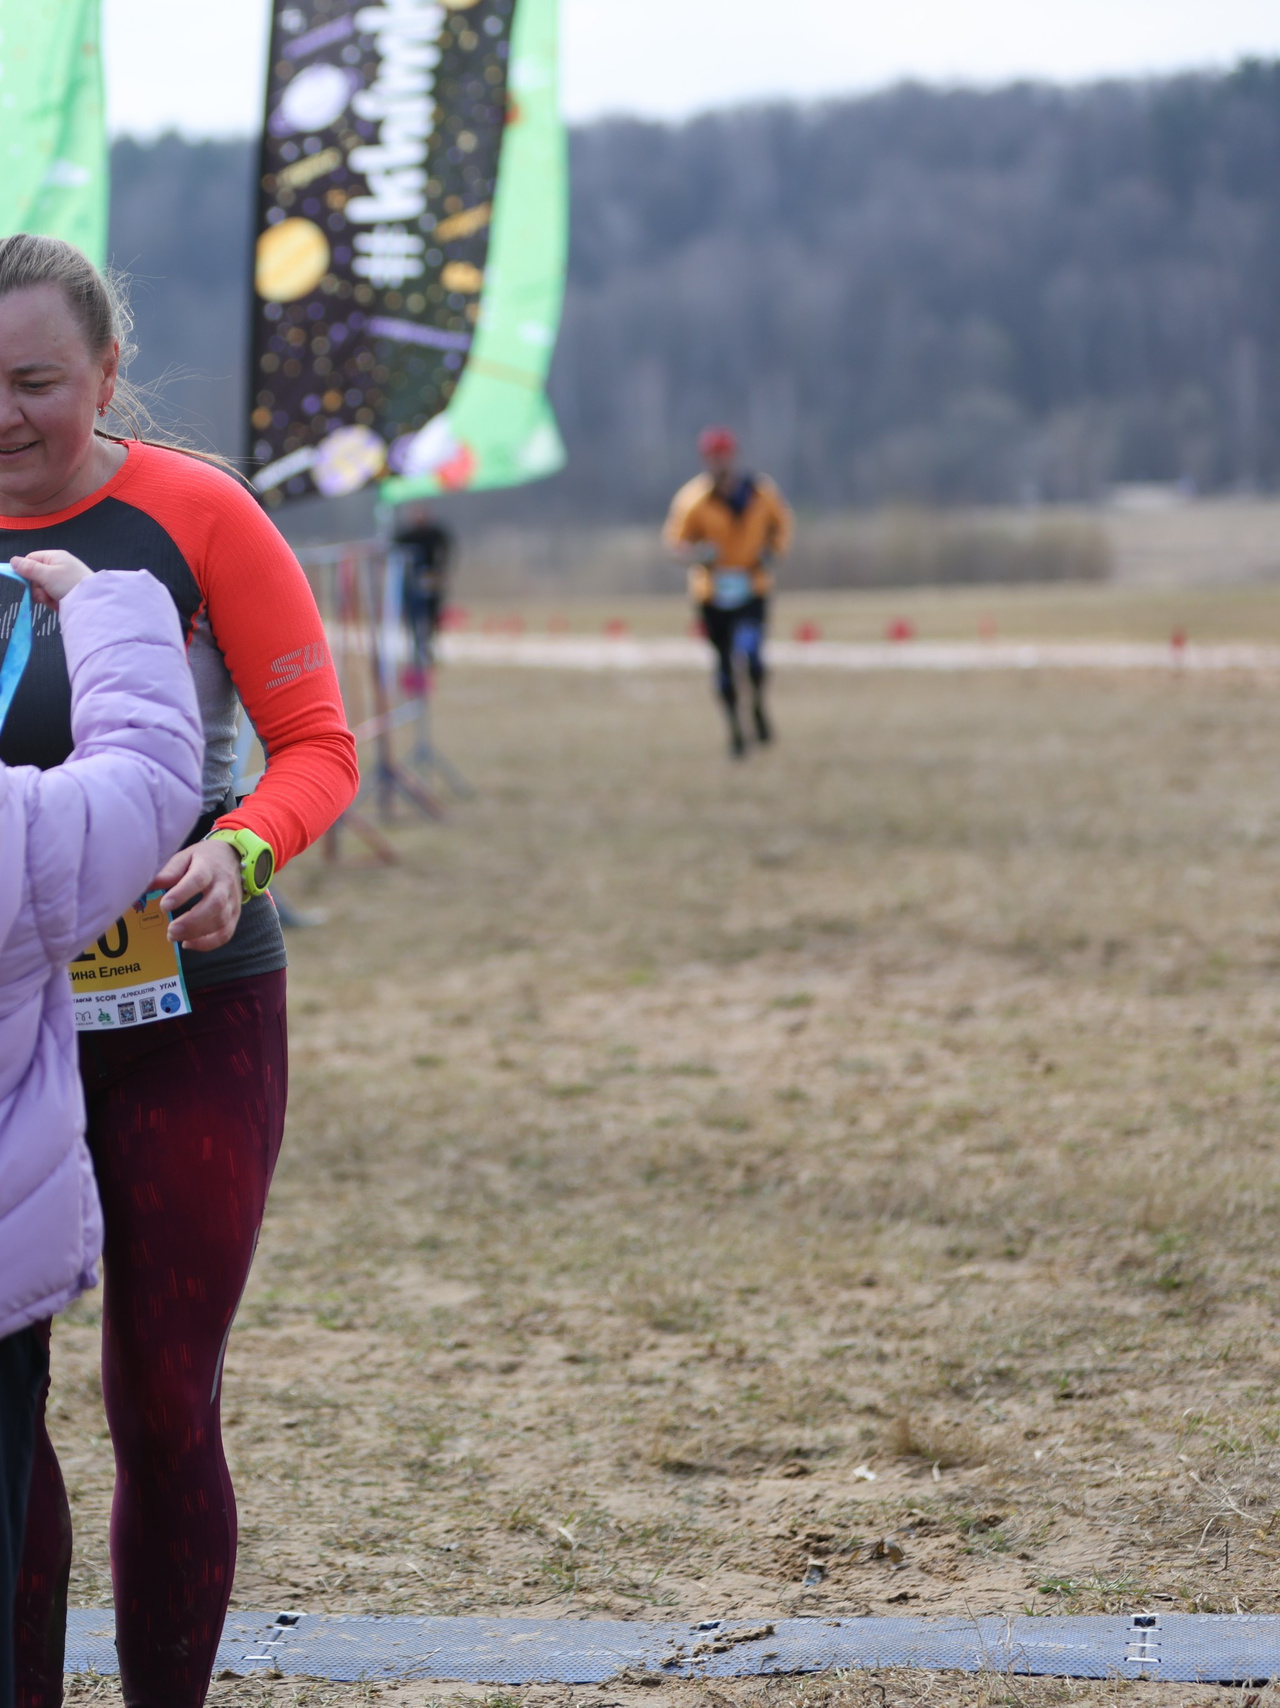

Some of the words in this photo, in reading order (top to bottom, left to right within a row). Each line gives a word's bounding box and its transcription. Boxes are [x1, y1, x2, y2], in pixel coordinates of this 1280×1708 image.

[70, 915, 129, 962] 0
[99, 962, 142, 978] Елена
[95, 994, 117, 1003] SCOR
